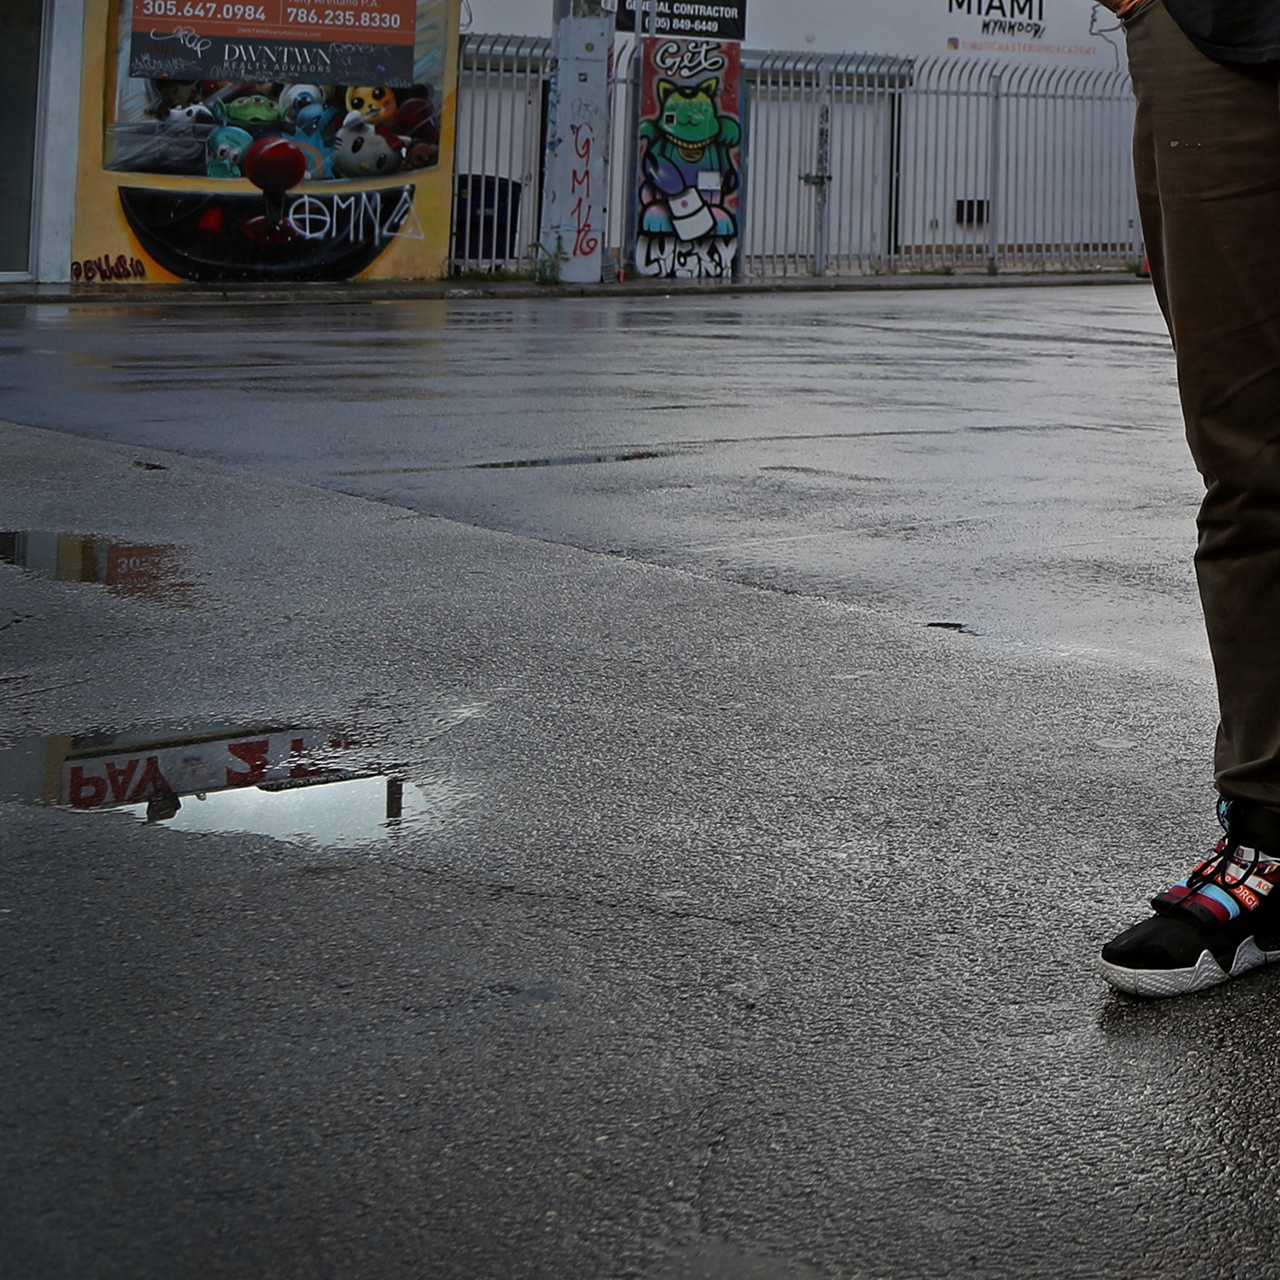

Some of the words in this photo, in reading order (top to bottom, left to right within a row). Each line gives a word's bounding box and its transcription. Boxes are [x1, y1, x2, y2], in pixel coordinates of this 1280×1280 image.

[142, 0, 266, 21] 305.647.0984
[287, 7, 401, 28] 786.235.8330
[673, 3, 738, 18] CONTRACTOR
[645, 18, 670, 30] (05)
[672, 19, 718, 32] 849-6449
[223, 44, 331, 65] DWNTWN
[656, 41, 723, 77] Get
[223, 61, 267, 70] REALTY
[274, 63, 331, 73] ADVISORS
